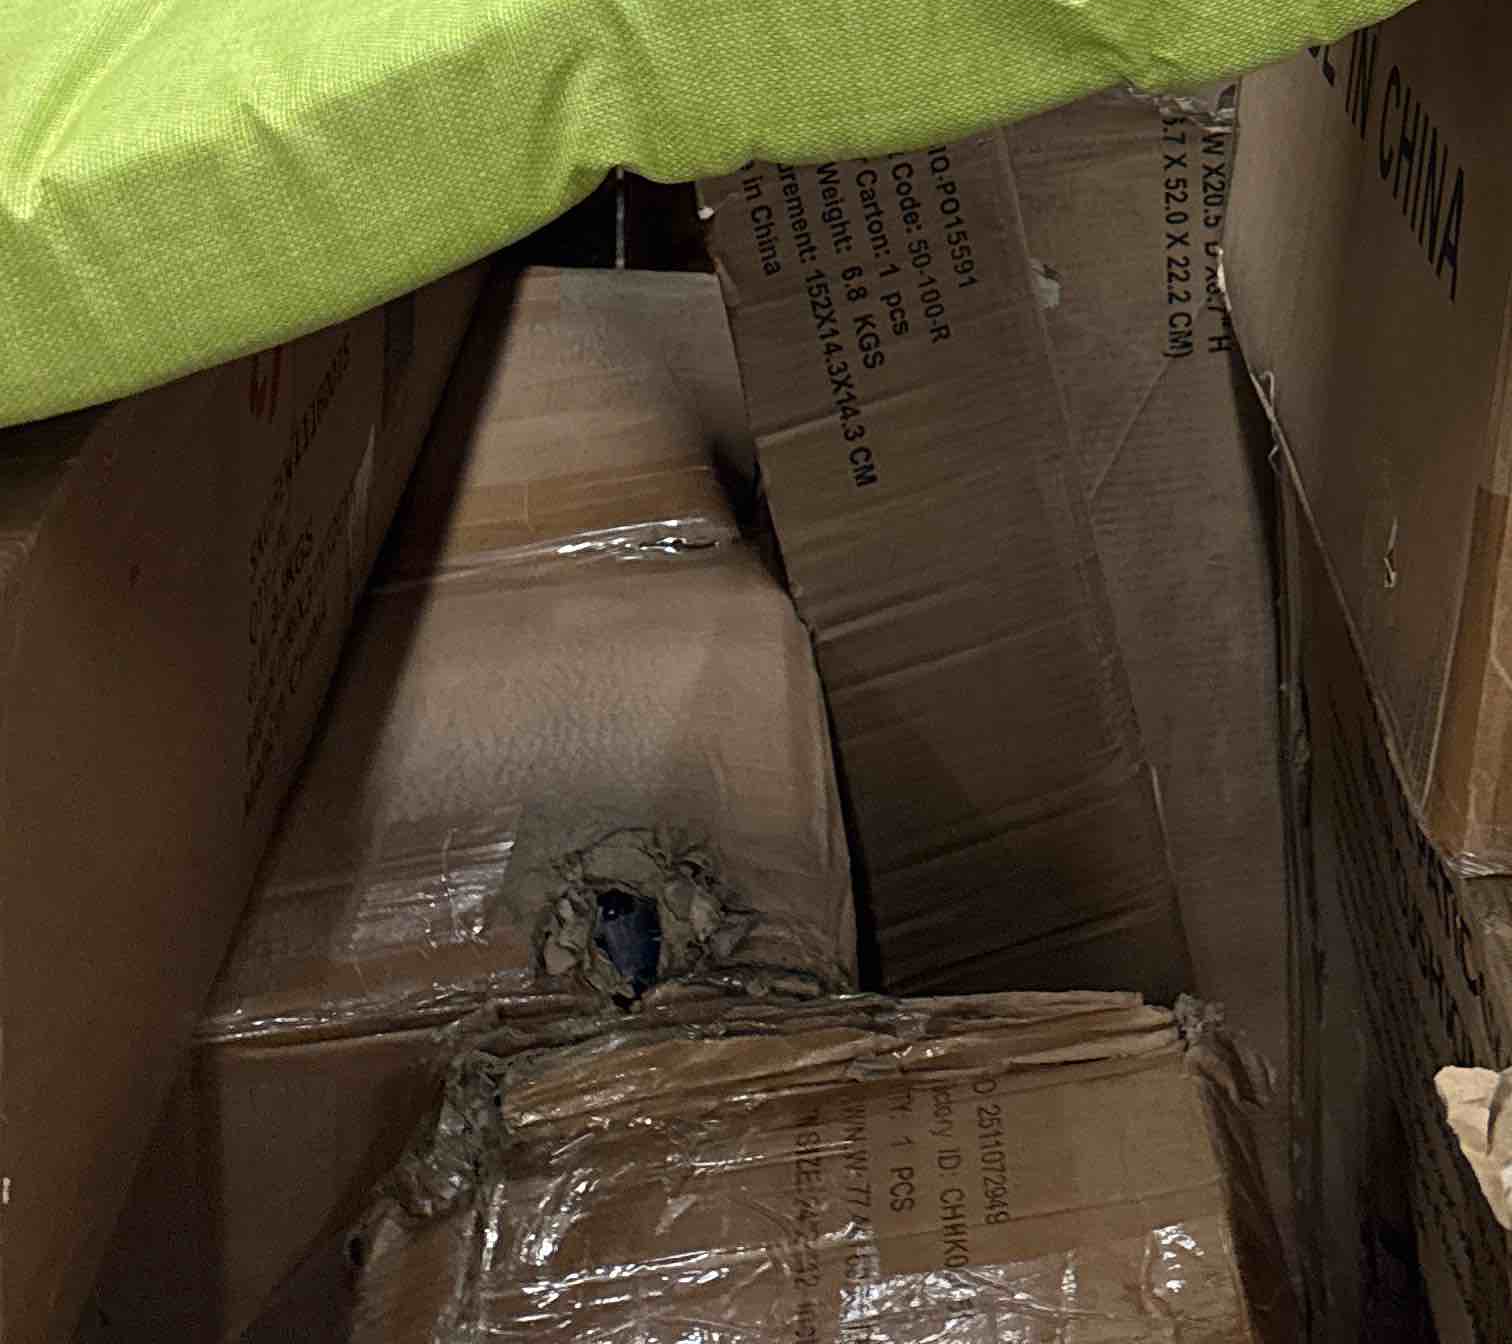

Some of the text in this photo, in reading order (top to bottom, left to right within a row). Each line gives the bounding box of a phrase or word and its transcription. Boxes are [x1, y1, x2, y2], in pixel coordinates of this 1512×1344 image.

[751, 204, 781, 276] China
[1164, 177, 1189, 225] 52.0
[1378, 64, 1466, 303] CHINA
[816, 162, 885, 369] Weight: 6.8 KGS
[855, 169, 909, 336] Carton: 1 pcs
[891, 162, 950, 344] Code: 50-100-R
[1167, 255, 1192, 305] 22.2
[776, 162, 878, 488] urement: 152X14.3X14.3 CM
[1163, 312, 1194, 360] CM)
[889, 1166, 916, 1213] PCS
